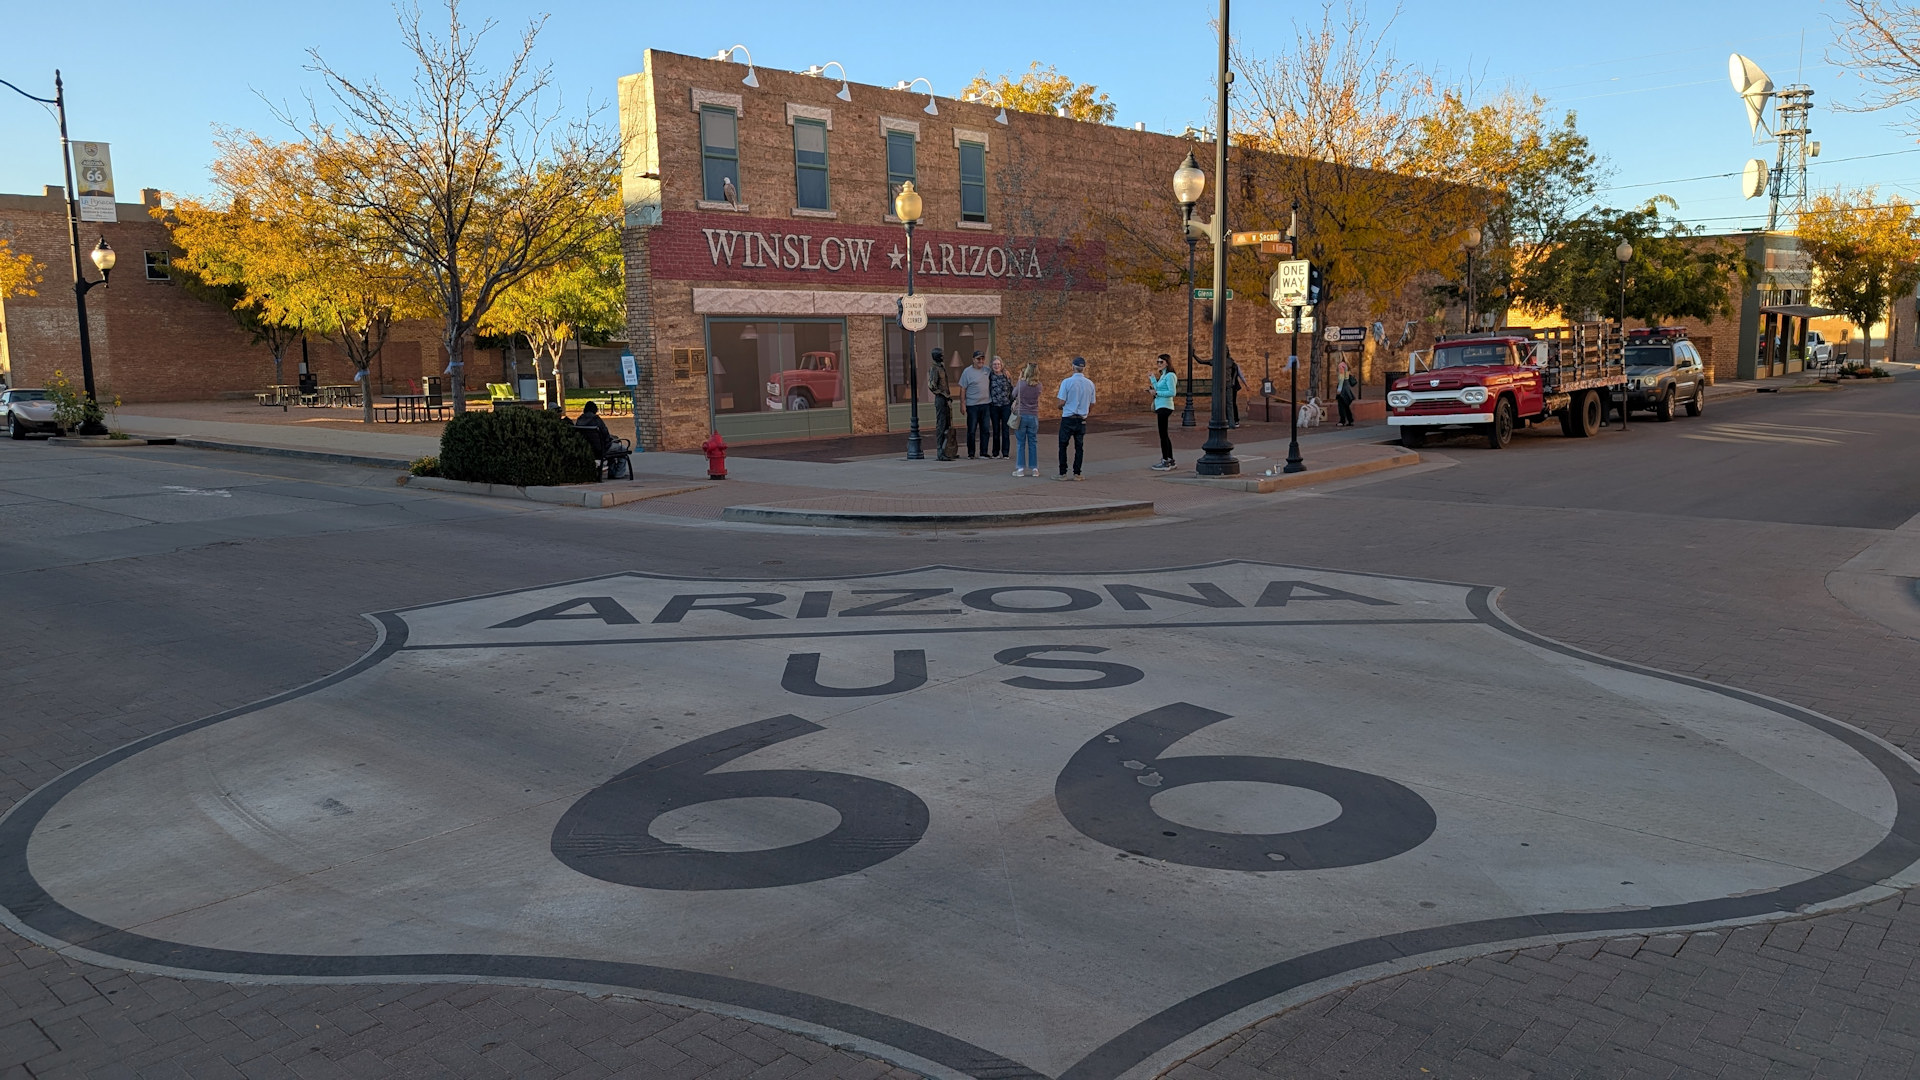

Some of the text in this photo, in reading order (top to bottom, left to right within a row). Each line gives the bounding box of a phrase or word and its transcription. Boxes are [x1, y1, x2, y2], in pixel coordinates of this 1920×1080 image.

[87, 171, 102, 181] 66
[1259, 232, 1279, 242] Secon
[702, 228, 1044, 279] WINSLOW ARIZONA
[1283, 265, 1304, 276] ONE
[1282, 277, 1305, 288] WAY
[1326, 332, 1338, 340] 66
[489, 580, 1398, 629] ARIZONA
[550, 702, 1437, 891] 66
